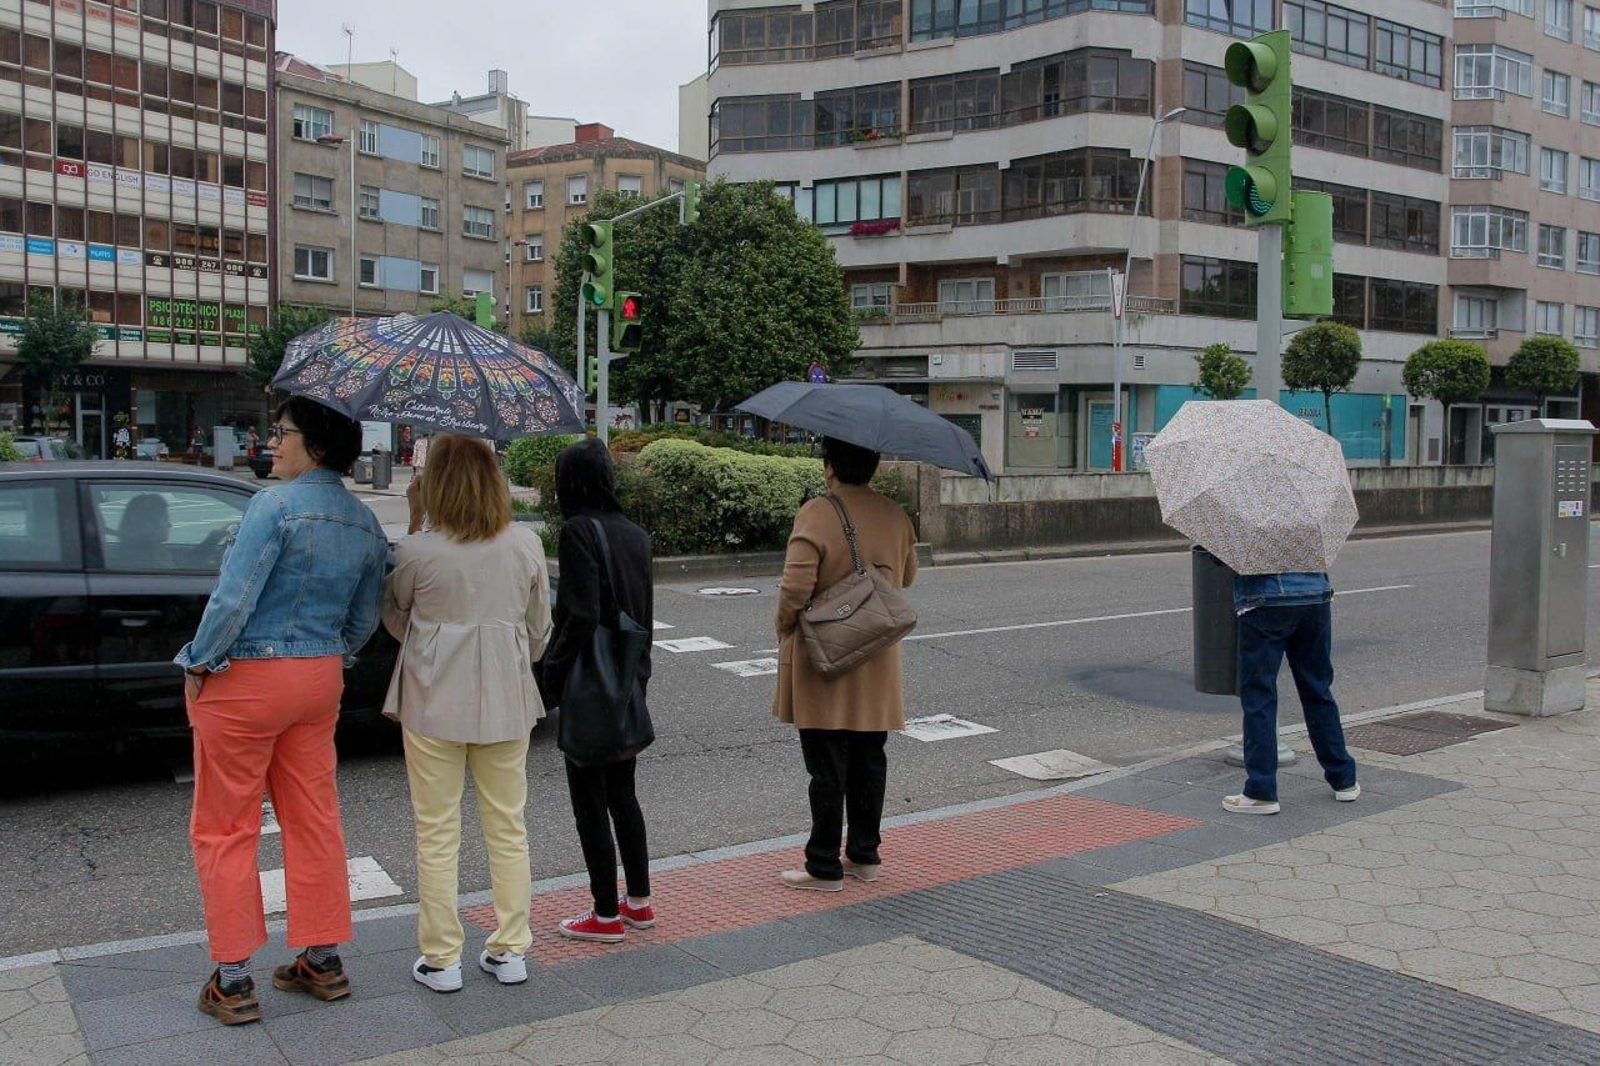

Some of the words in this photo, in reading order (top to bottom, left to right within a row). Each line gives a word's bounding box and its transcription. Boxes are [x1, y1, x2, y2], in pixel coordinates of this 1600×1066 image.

[87, 168, 100, 177] GO
[102, 170, 139, 183] ENGLISH
[152, 315, 171, 326] 986
[175, 318, 194, 328] 212
